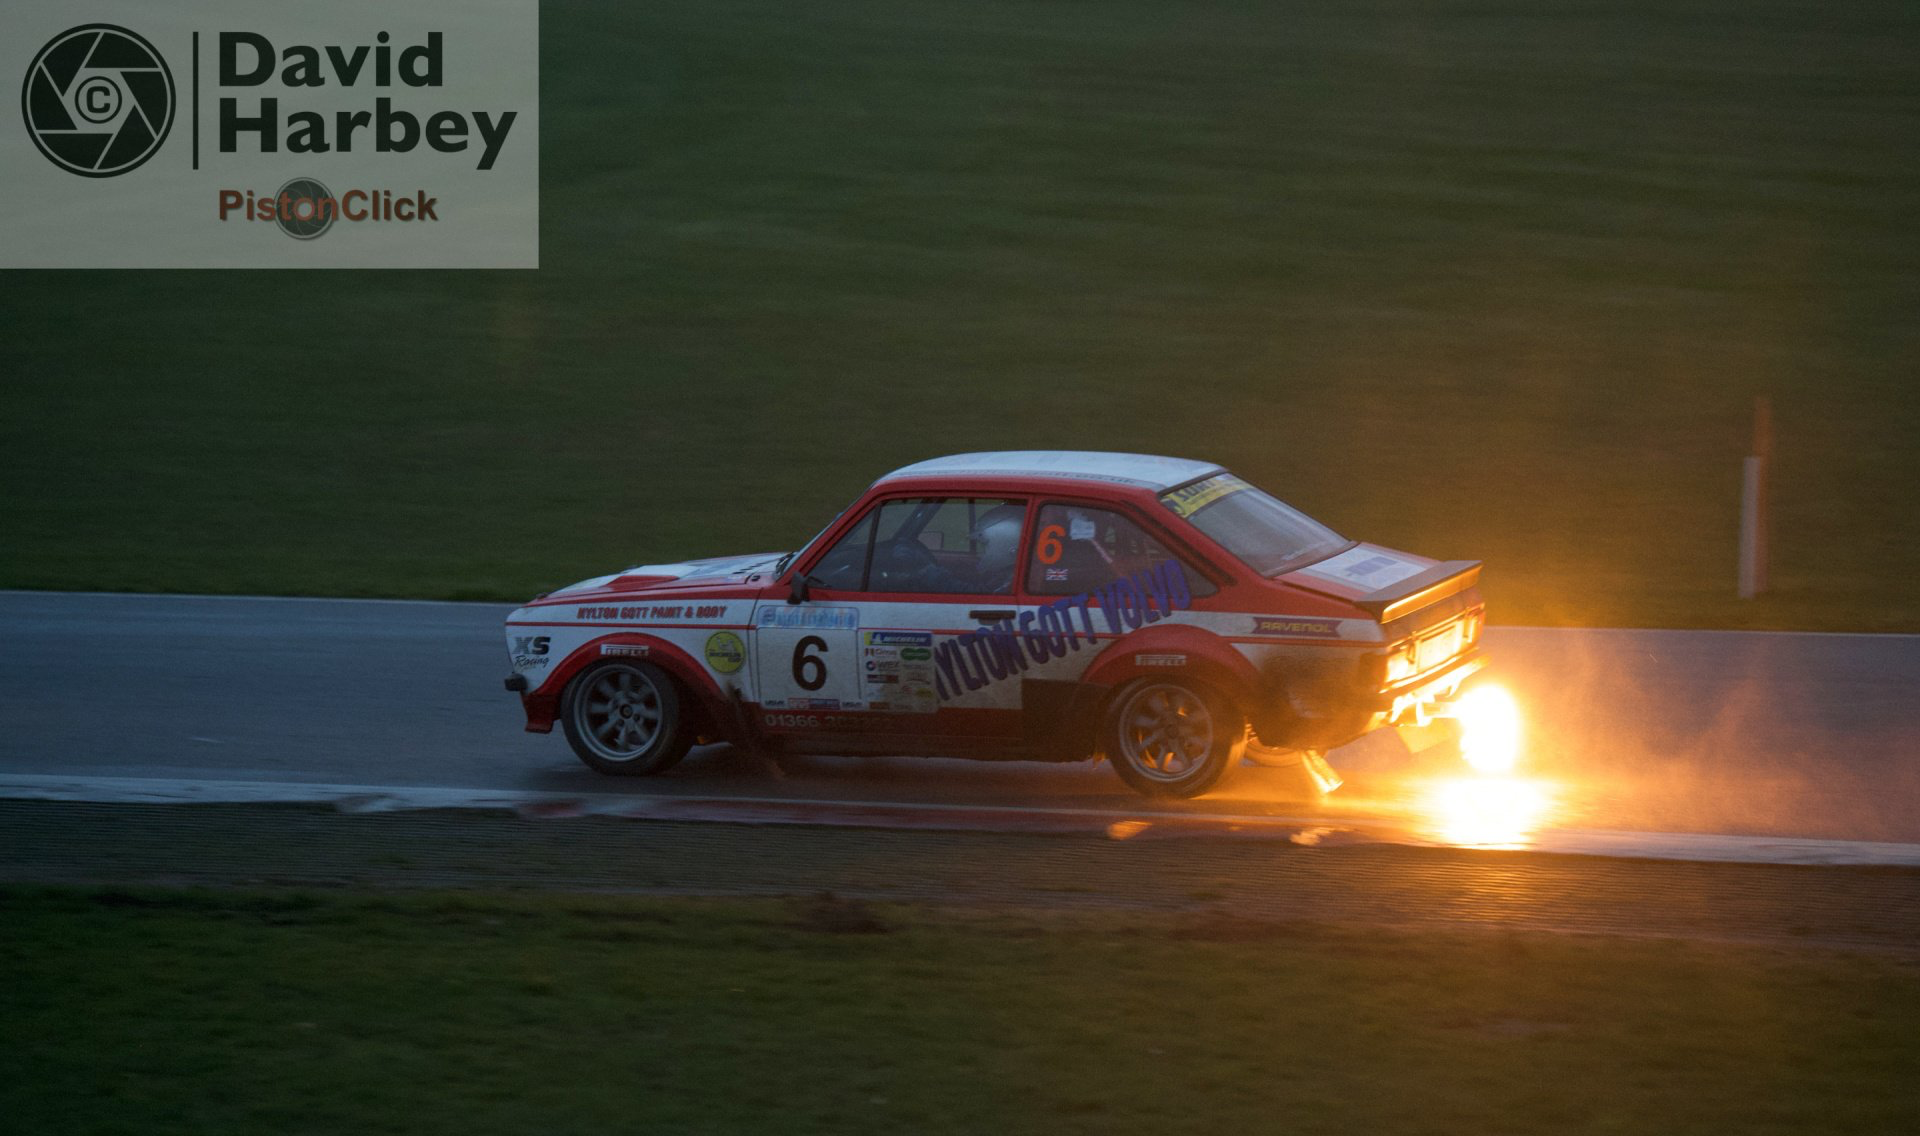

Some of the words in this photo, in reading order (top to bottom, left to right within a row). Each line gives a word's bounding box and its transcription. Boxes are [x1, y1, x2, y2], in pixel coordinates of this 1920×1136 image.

[1037, 525, 1067, 564] 6
[620, 606, 650, 619] GOTT
[651, 606, 683, 619] PAINT
[684, 606, 694, 619] &
[696, 605, 728, 618] BODY
[1019, 592, 1098, 664] GOTT
[1094, 559, 1192, 634] VOLVO
[1259, 620, 1333, 633] RAVENOL
[512, 636, 552, 655] XS
[514, 655, 550, 668] Racing
[792, 635, 829, 692] 6
[765, 713, 819, 728] 01366
